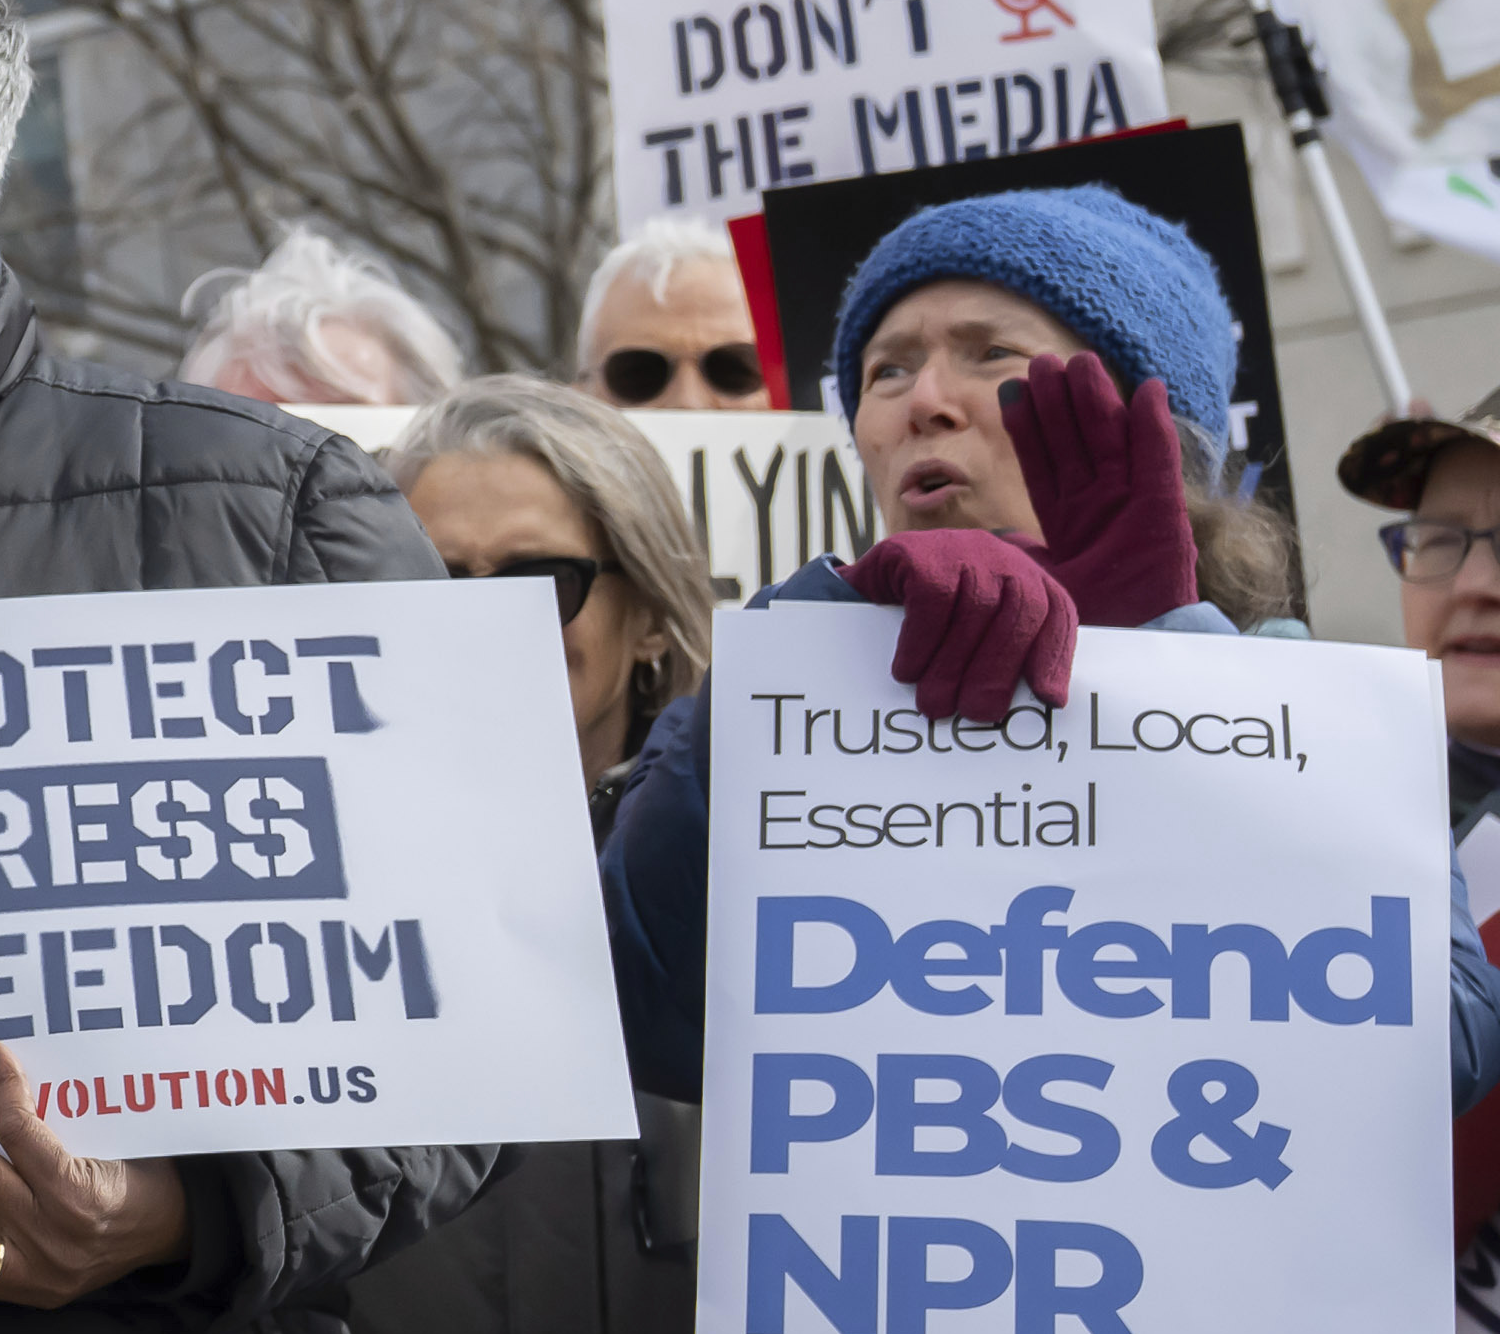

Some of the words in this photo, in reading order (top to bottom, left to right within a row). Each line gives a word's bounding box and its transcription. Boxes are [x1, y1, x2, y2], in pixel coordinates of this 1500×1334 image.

[644, 106, 815, 205] THE
[853, 62, 1130, 178] MEDIA
[751, 693, 1069, 763] Trusted,
[1090, 691, 1308, 773] Local,
[757, 781, 1097, 850] Essential
[753, 885, 1414, 1027] Defend
[749, 1052, 1122, 1183] PBS
[1150, 1058, 1294, 1192] &
